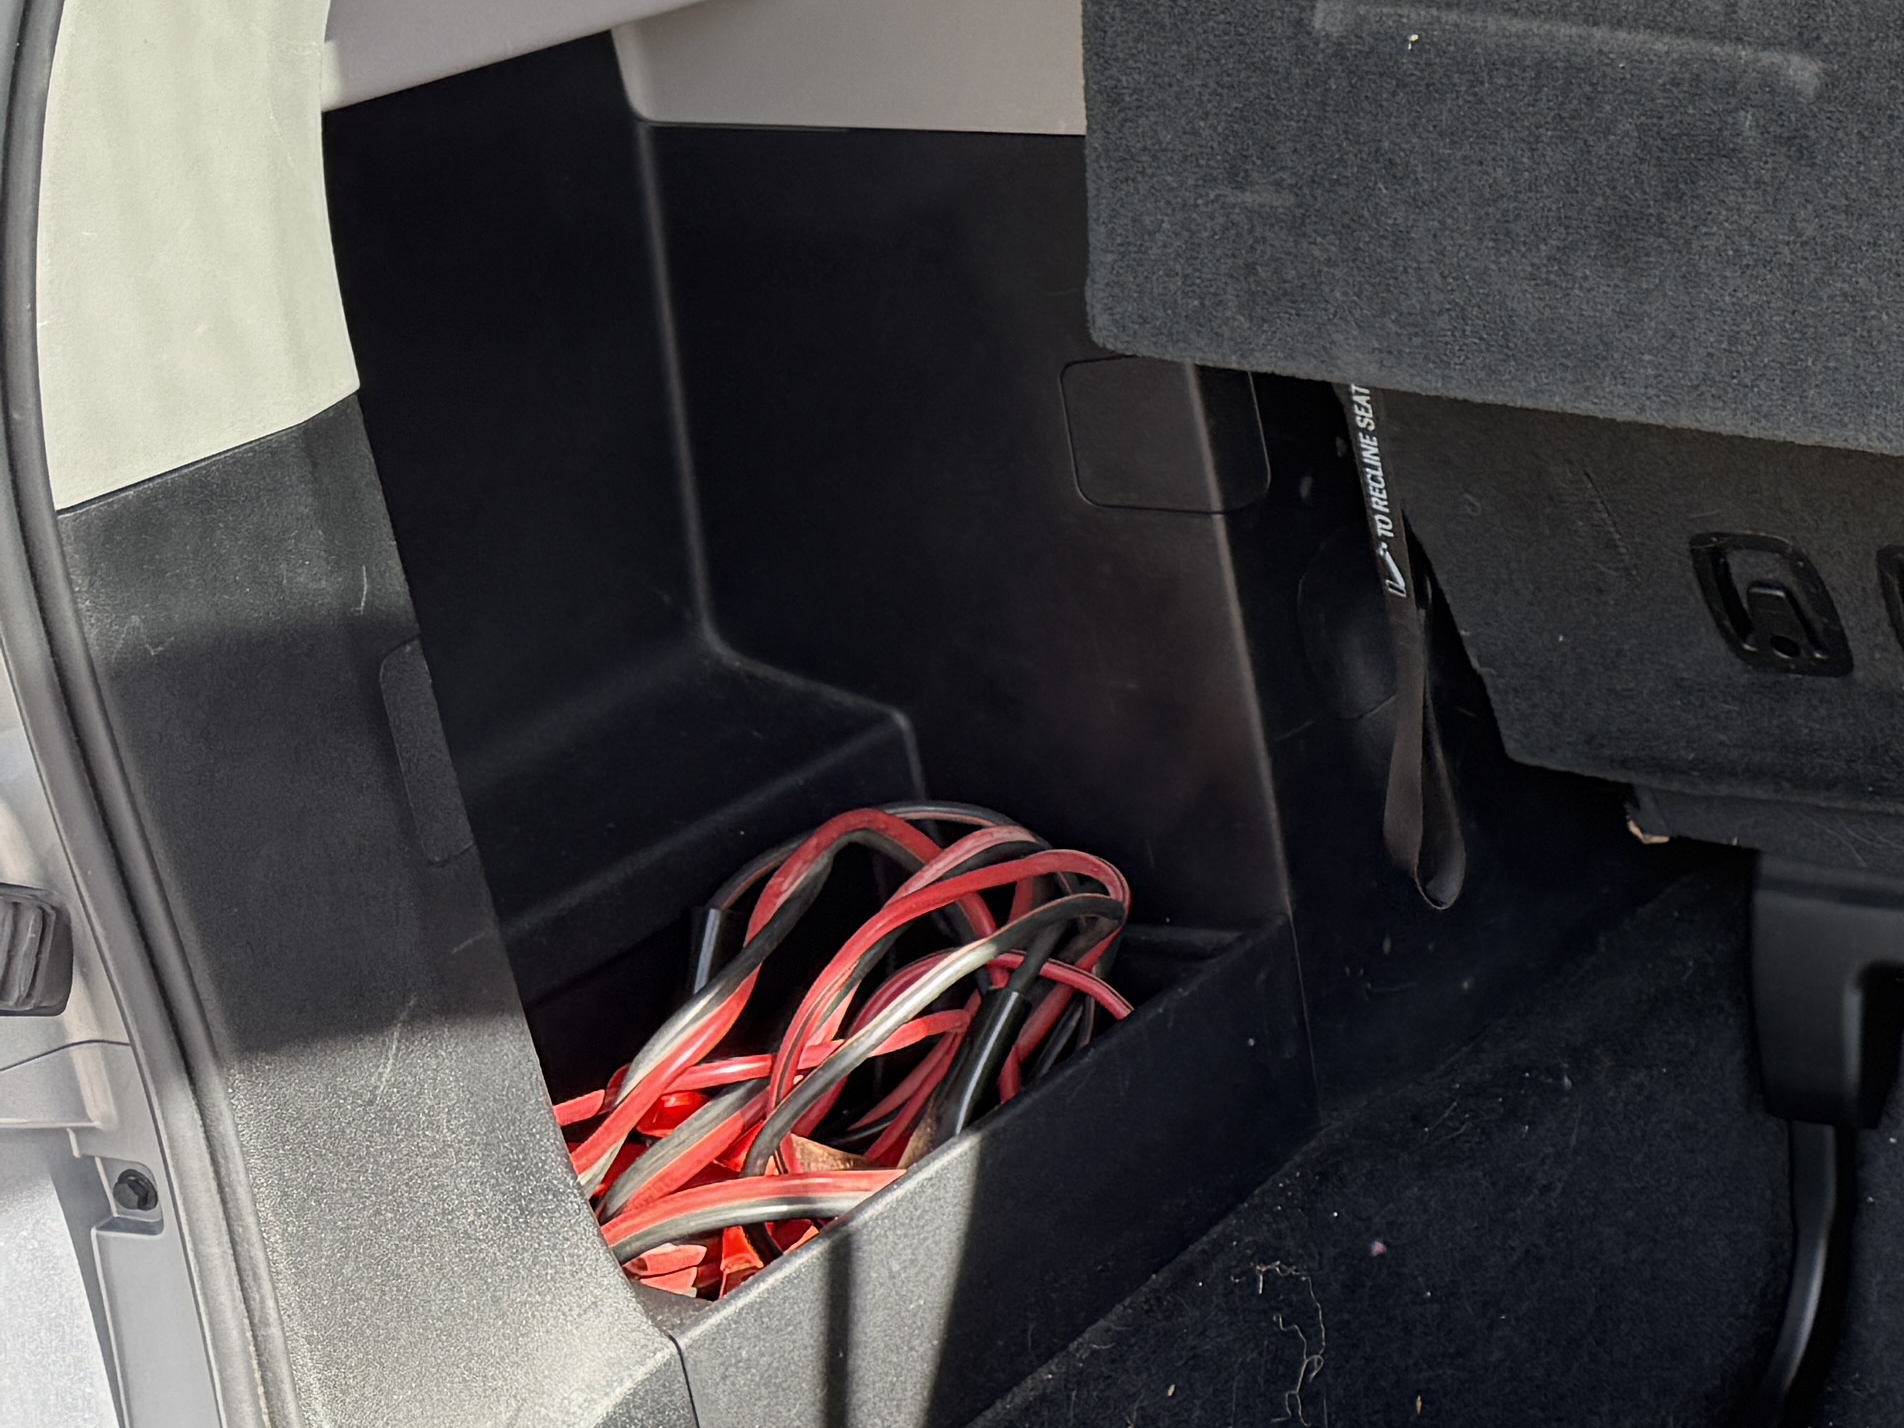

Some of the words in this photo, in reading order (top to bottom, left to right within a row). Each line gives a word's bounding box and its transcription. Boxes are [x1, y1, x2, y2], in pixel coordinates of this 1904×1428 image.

[1351, 383, 1376, 432] SEAT
[1358, 432, 1391, 513] RECLINE
[1373, 514, 1395, 538] TO
